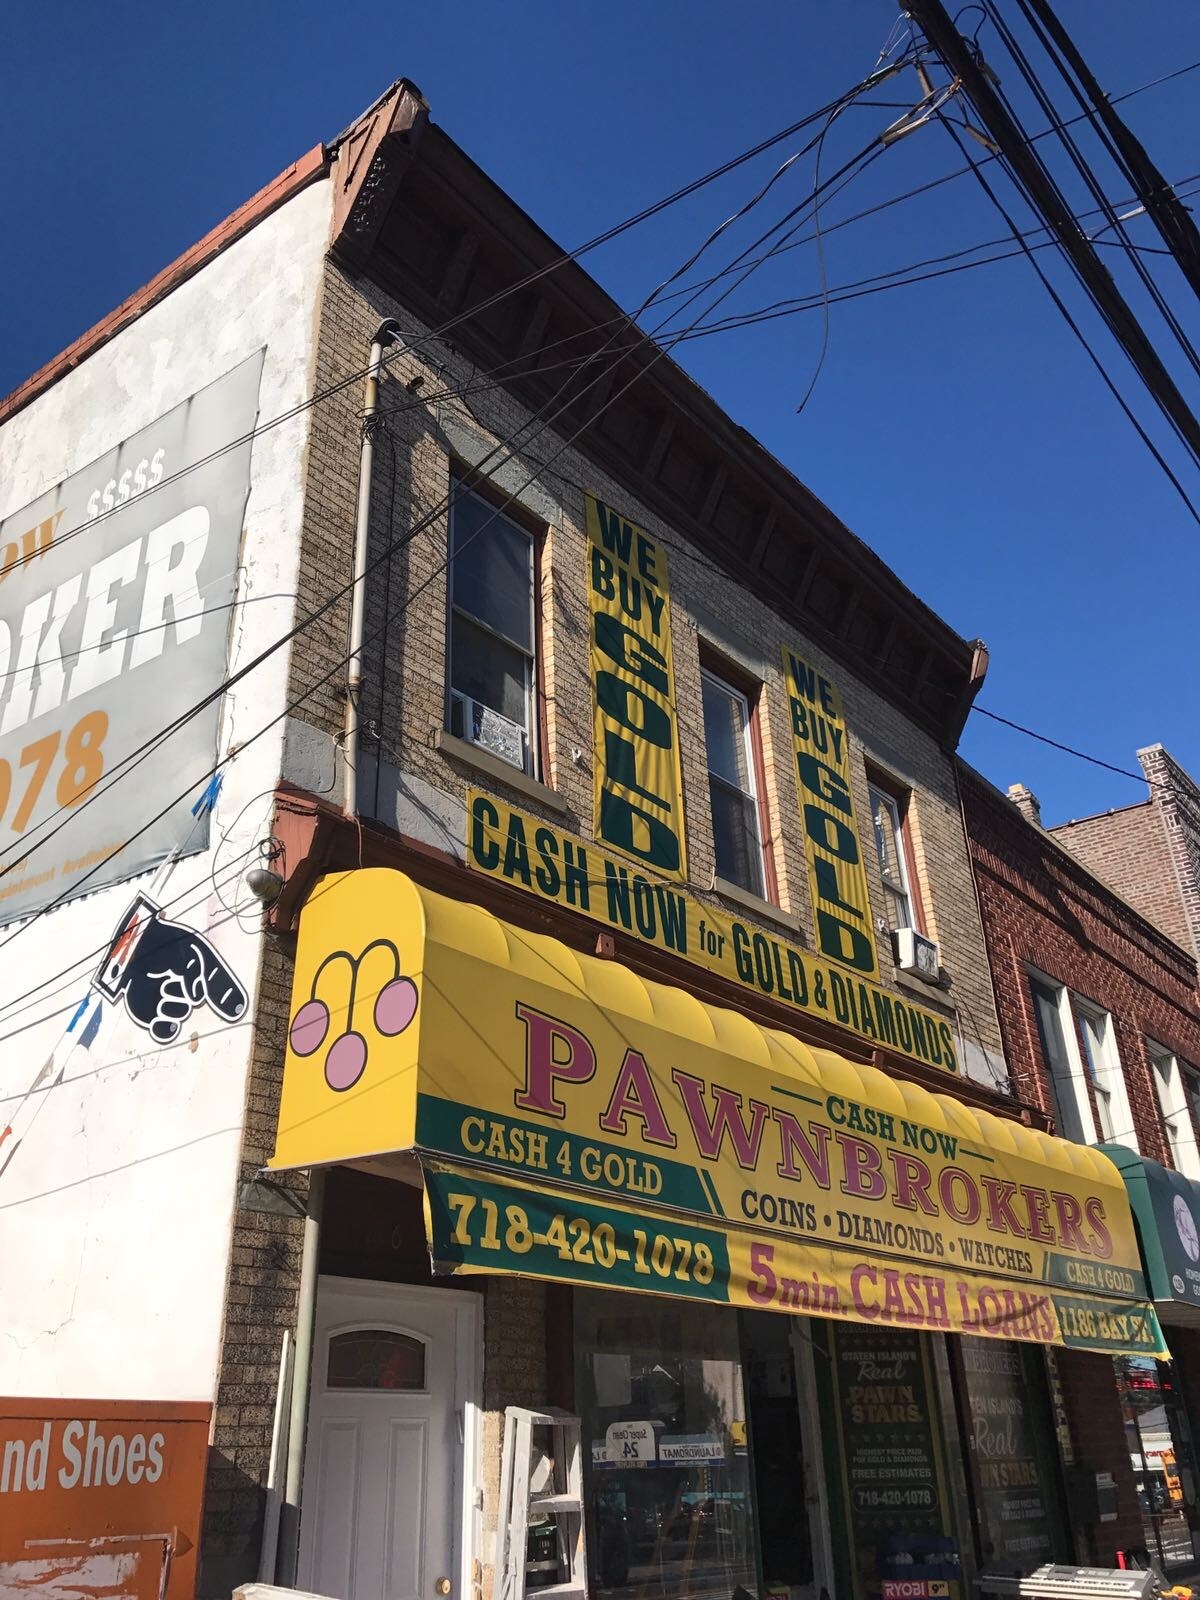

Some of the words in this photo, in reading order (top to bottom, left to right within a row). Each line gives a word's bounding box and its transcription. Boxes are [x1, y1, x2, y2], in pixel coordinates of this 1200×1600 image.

[596, 500, 659, 587] WE
[592, 545, 665, 638] BUY
[789, 652, 837, 720] WE
[594, 611, 680, 871] GOLD
[789, 695, 843, 765] BUY
[797, 751, 875, 973] GOLD
[472, 797, 591, 912] CASH
[604, 859, 688, 955] NOW
[699, 920, 725, 959] for
[731, 923, 809, 1008] GOLD
[814, 969, 829, 1010] &
[828, 969, 957, 1073] DIAMONDS
[460, 1116, 549, 1170] CASH
[556, 1141, 572, 1175] 4
[580, 1146, 663, 1196] GOLD
[514, 1000, 1114, 1260] PAWNBROKERS
[826, 1095, 897, 1142] CASH
[900, 1120, 959, 1161] NOW
[448, 1192, 714, 1286] 718-420-1078
[741, 1189, 817, 1232] COINS
[837, 1210, 945, 1257] DIAMONDS
[958, 1237, 1033, 1274] WATCHES
[850, 1263, 950, 1328] CASH
[956, 1280, 1057, 1341] LOANS
[1066, 1260, 1095, 1287] CASH
[1105, 1269, 1136, 1293] GOLD
[1059, 1306, 1097, 1338] 1186
[1097, 1311, 1131, 1341] BAY
[848, 1385, 915, 1404] PAWN
[857, 1360, 907, 1381] Real
[58, 1420, 165, 1490] Shoes
[857, 1489, 931, 1505] 718-420-1078
[884, 1582, 925, 1597] RYOBI
